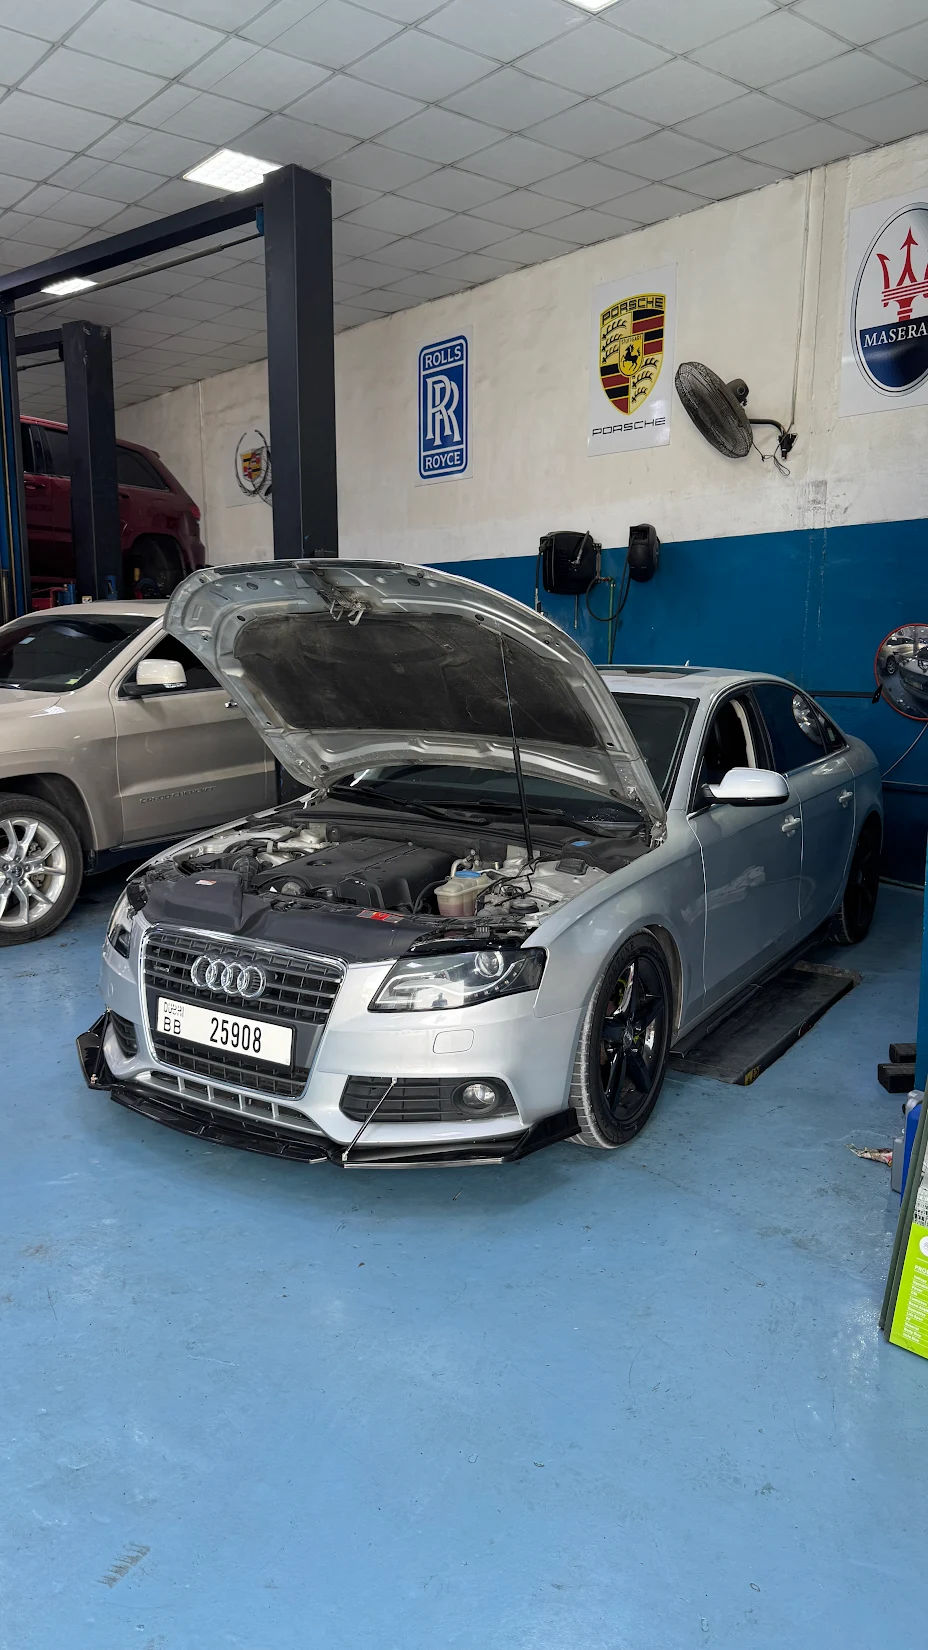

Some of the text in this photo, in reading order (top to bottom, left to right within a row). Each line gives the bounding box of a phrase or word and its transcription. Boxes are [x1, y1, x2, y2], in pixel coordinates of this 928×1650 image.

[602, 297, 664, 325] PORSCHE
[863, 321, 928, 348] MASERA
[425, 345, 462, 368] ROLLS
[592, 416, 666, 436] PORSCHE
[425, 452, 461, 469] ROYCE
[209, 1017, 262, 1053] 25908
